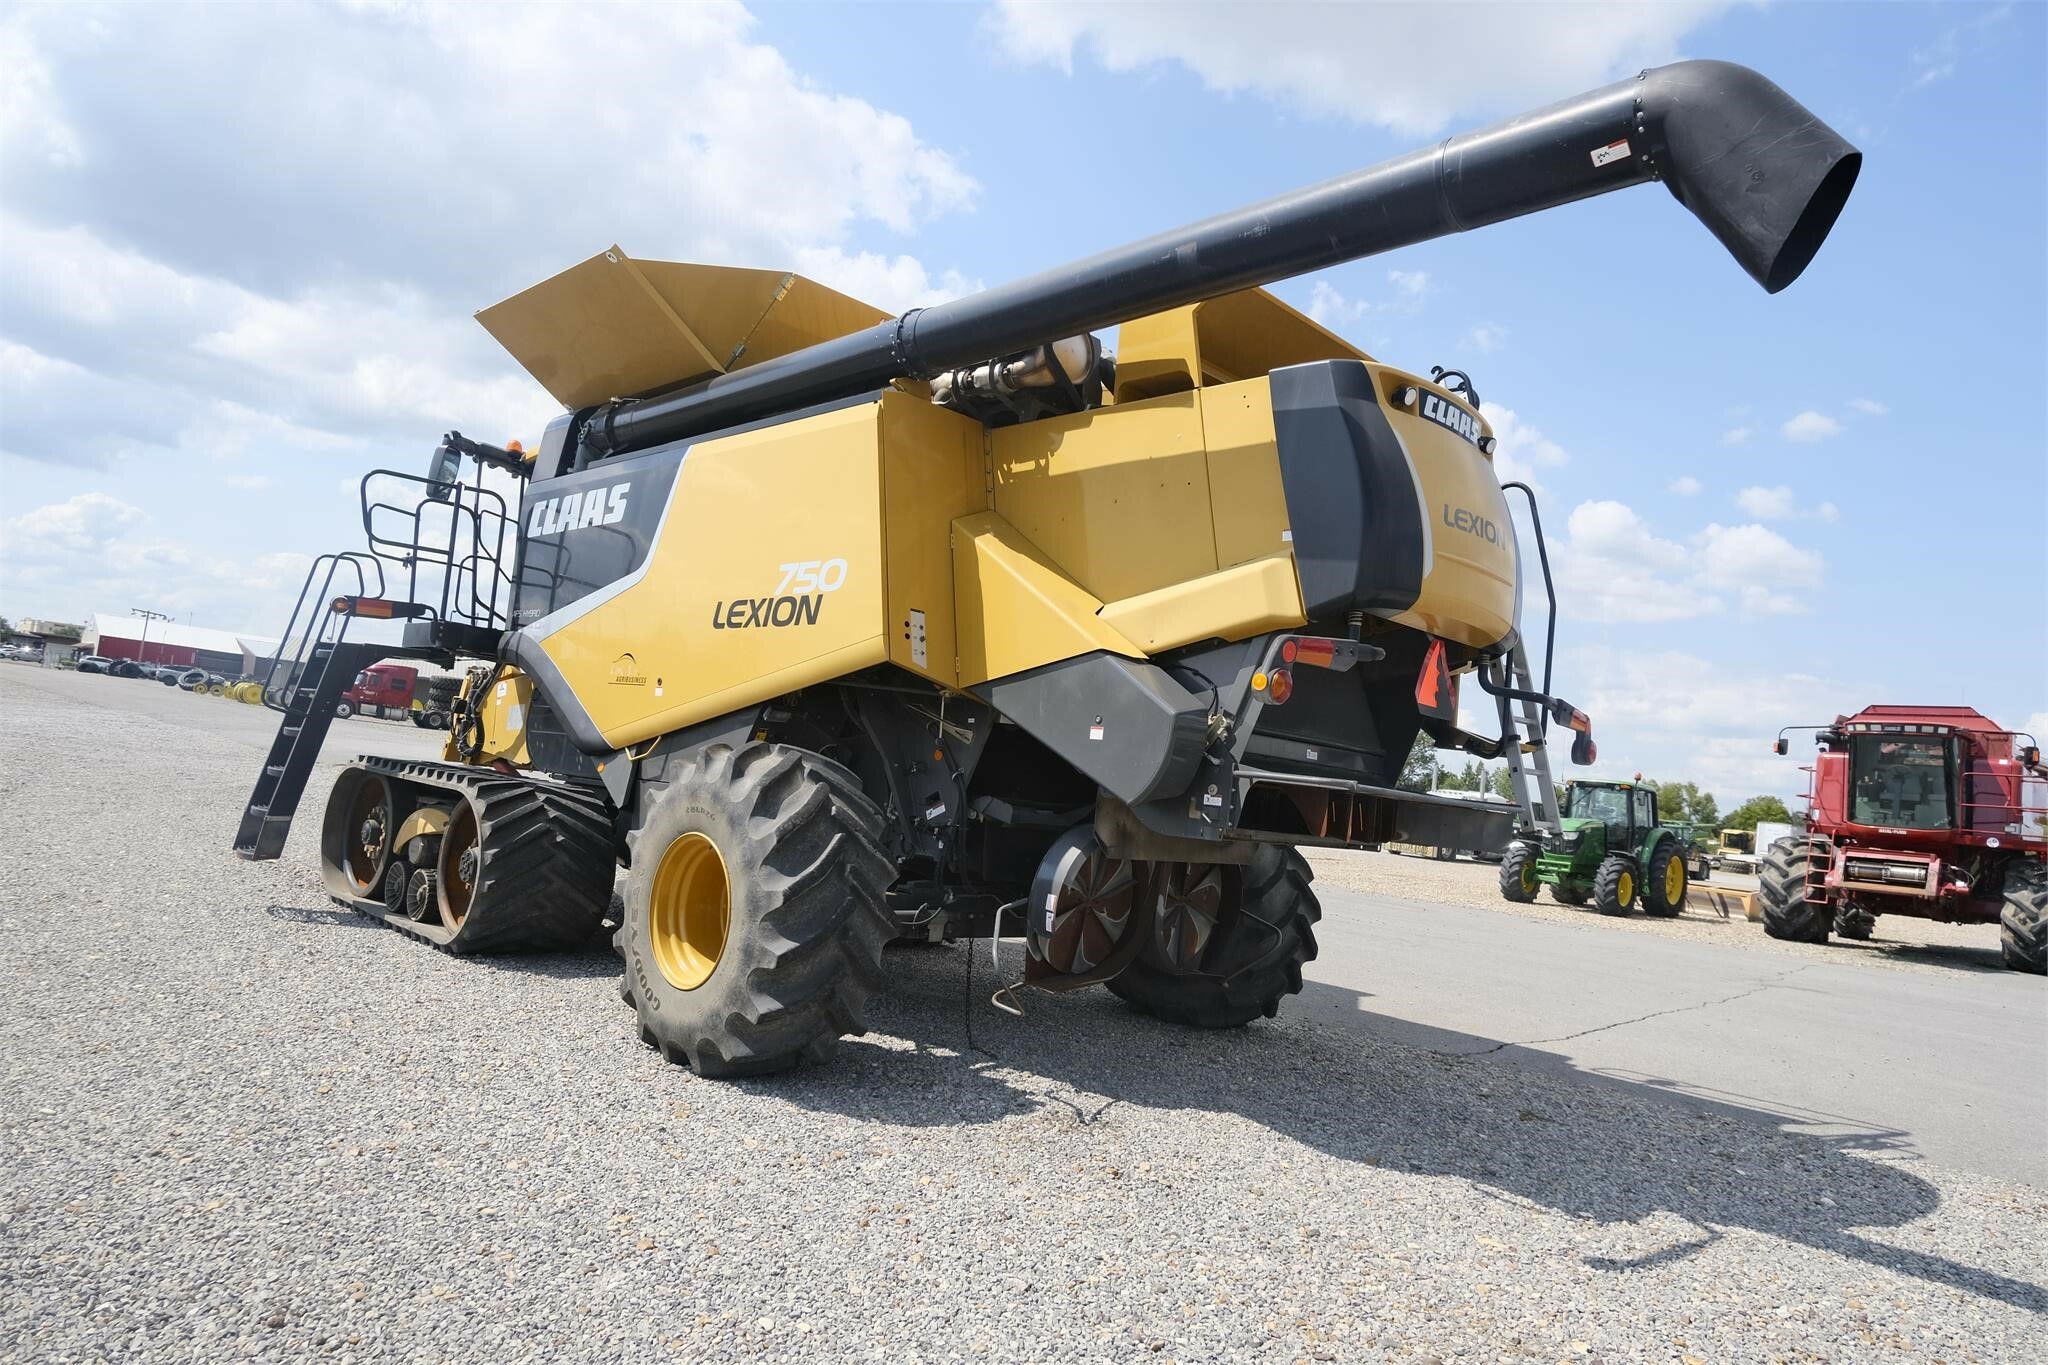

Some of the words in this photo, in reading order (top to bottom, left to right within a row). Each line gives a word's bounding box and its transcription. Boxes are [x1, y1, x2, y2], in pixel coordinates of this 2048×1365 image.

[1423, 394, 1482, 443] CLAAS
[527, 482, 631, 538] CLAAS
[1443, 504, 1507, 551] LEXION
[774, 558, 848, 596] 750
[713, 594, 824, 629] LEXION
[615, 675, 647, 684] AGRIBUSINESS
